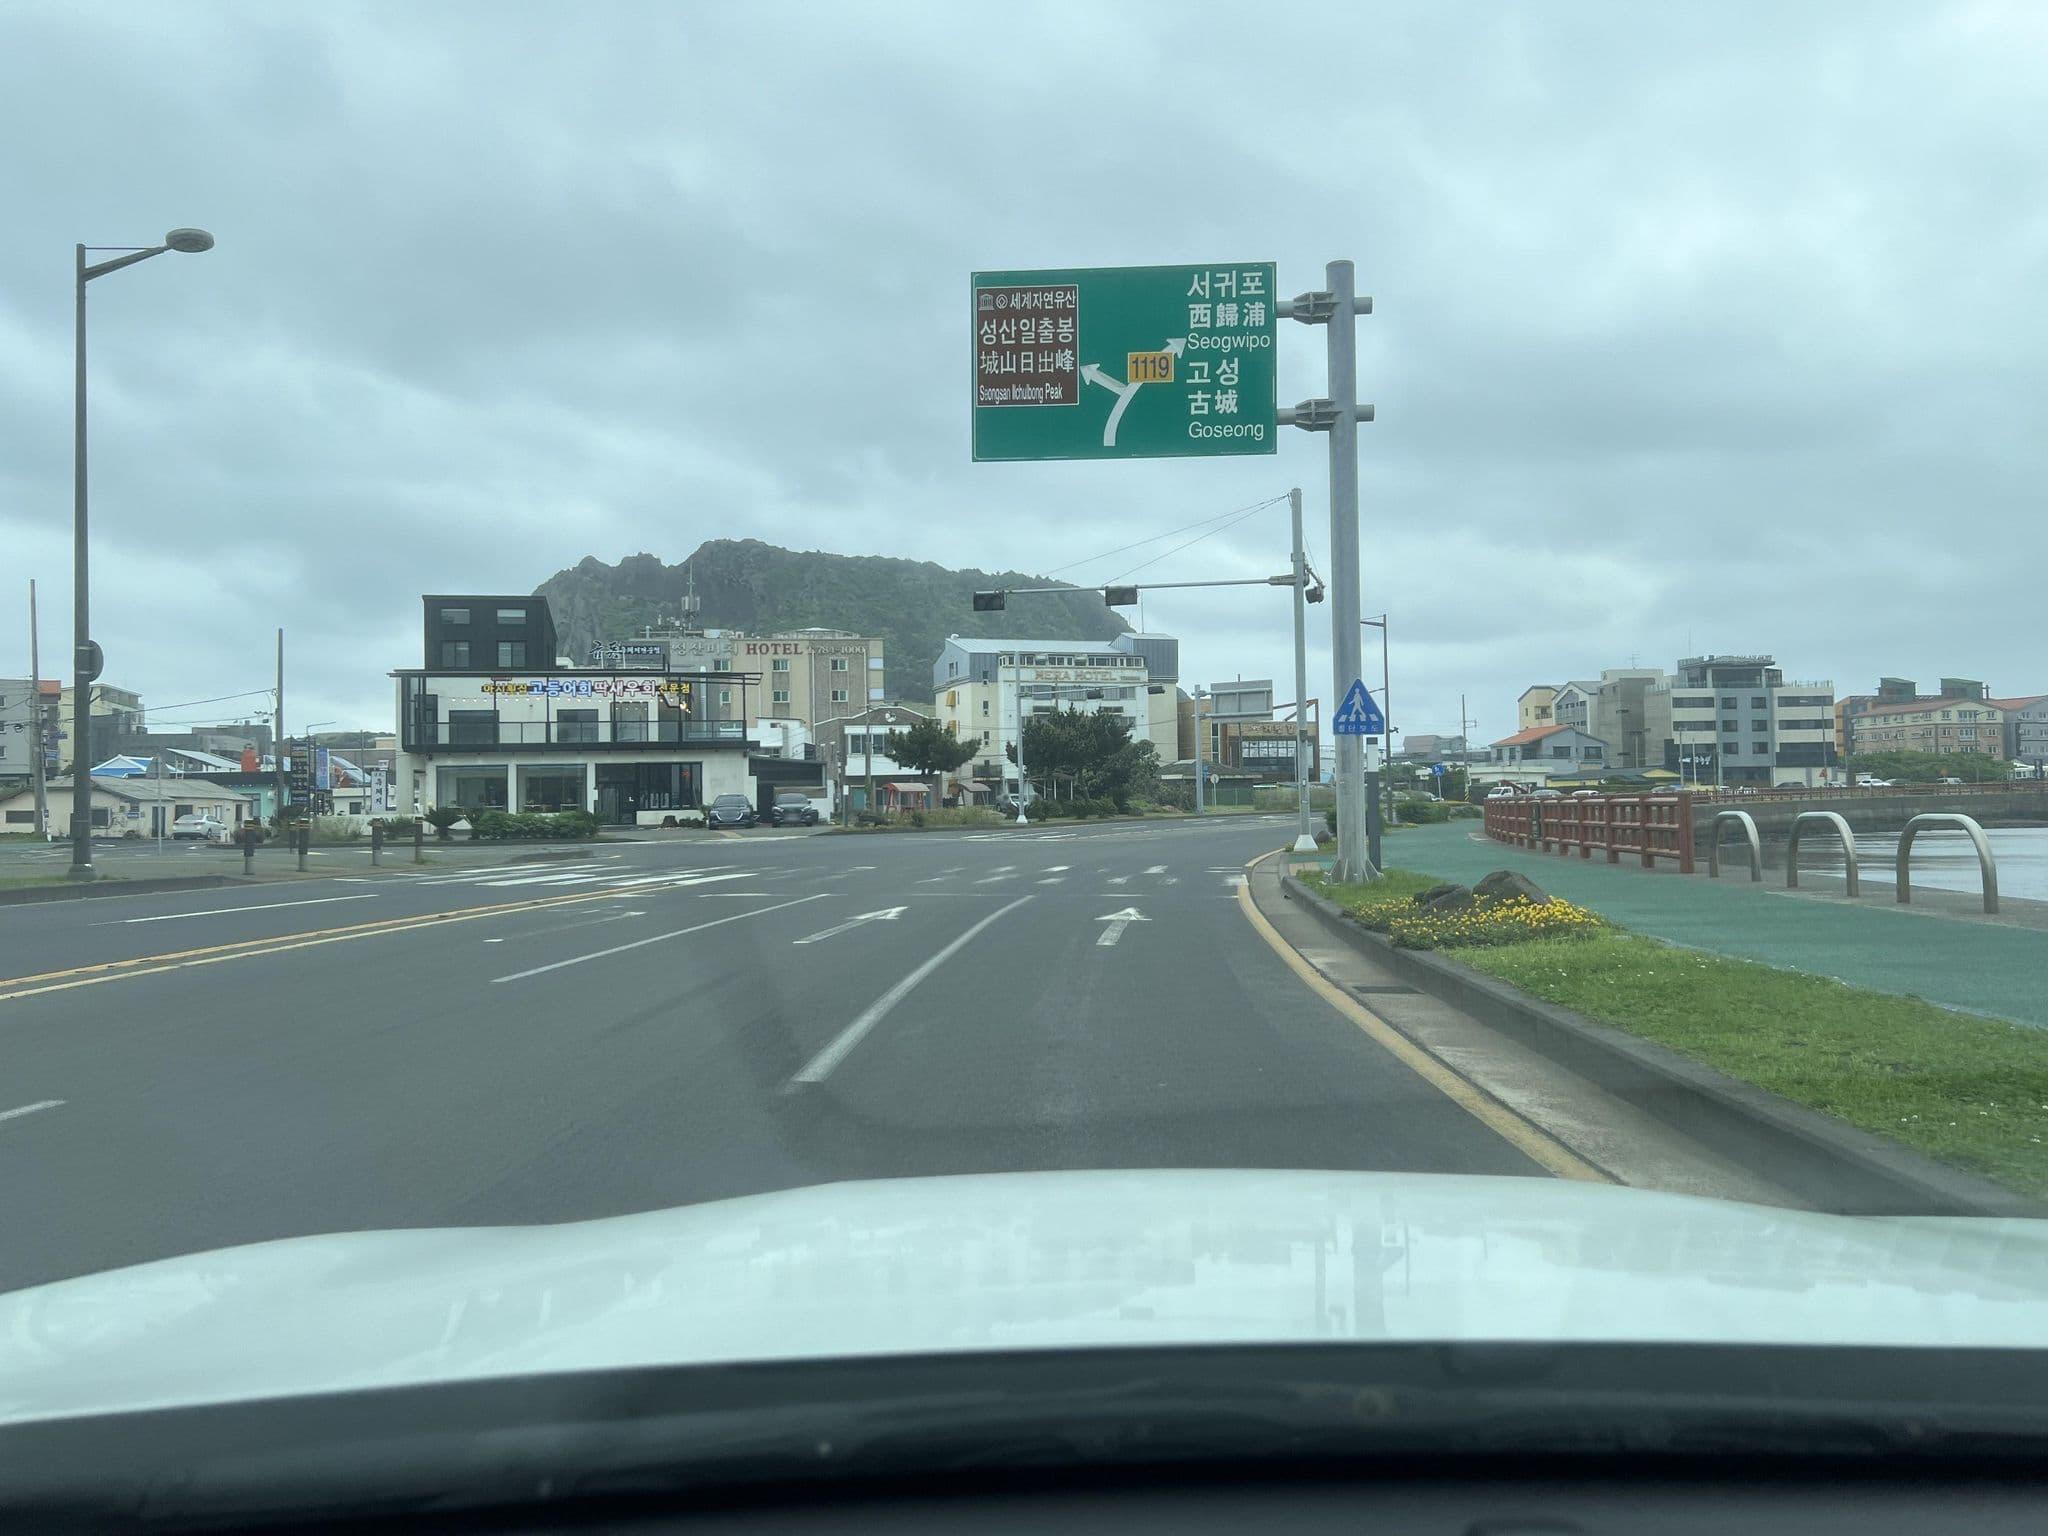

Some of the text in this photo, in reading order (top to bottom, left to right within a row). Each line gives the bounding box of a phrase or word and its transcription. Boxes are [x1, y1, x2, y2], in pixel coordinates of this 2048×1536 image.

[1187, 271, 1266, 299] 서귀포
[1010, 290, 1076, 310] 세계자연유산
[1188, 302, 1266, 329] 西歸浦
[980, 317, 1075, 345] 성산일출봉
[1187, 332, 1270, 352] Seogwipo
[980, 348, 1075, 374] 城山日出峰
[1131, 356, 1169, 379] 1119
[1186, 357, 1239, 386] 고성
[980, 384, 1010, 405] Seongsan
[1045, 382, 1063, 400] Peak
[1188, 390, 1238, 416] 古城
[1188, 422, 1264, 440] Goseong
[745, 643, 804, 655] HOTEL
[1074, 670, 1117, 681] HOTEL
[528, 679, 593, 697] 고등어회
[593, 679, 657, 697] 딱새우회
